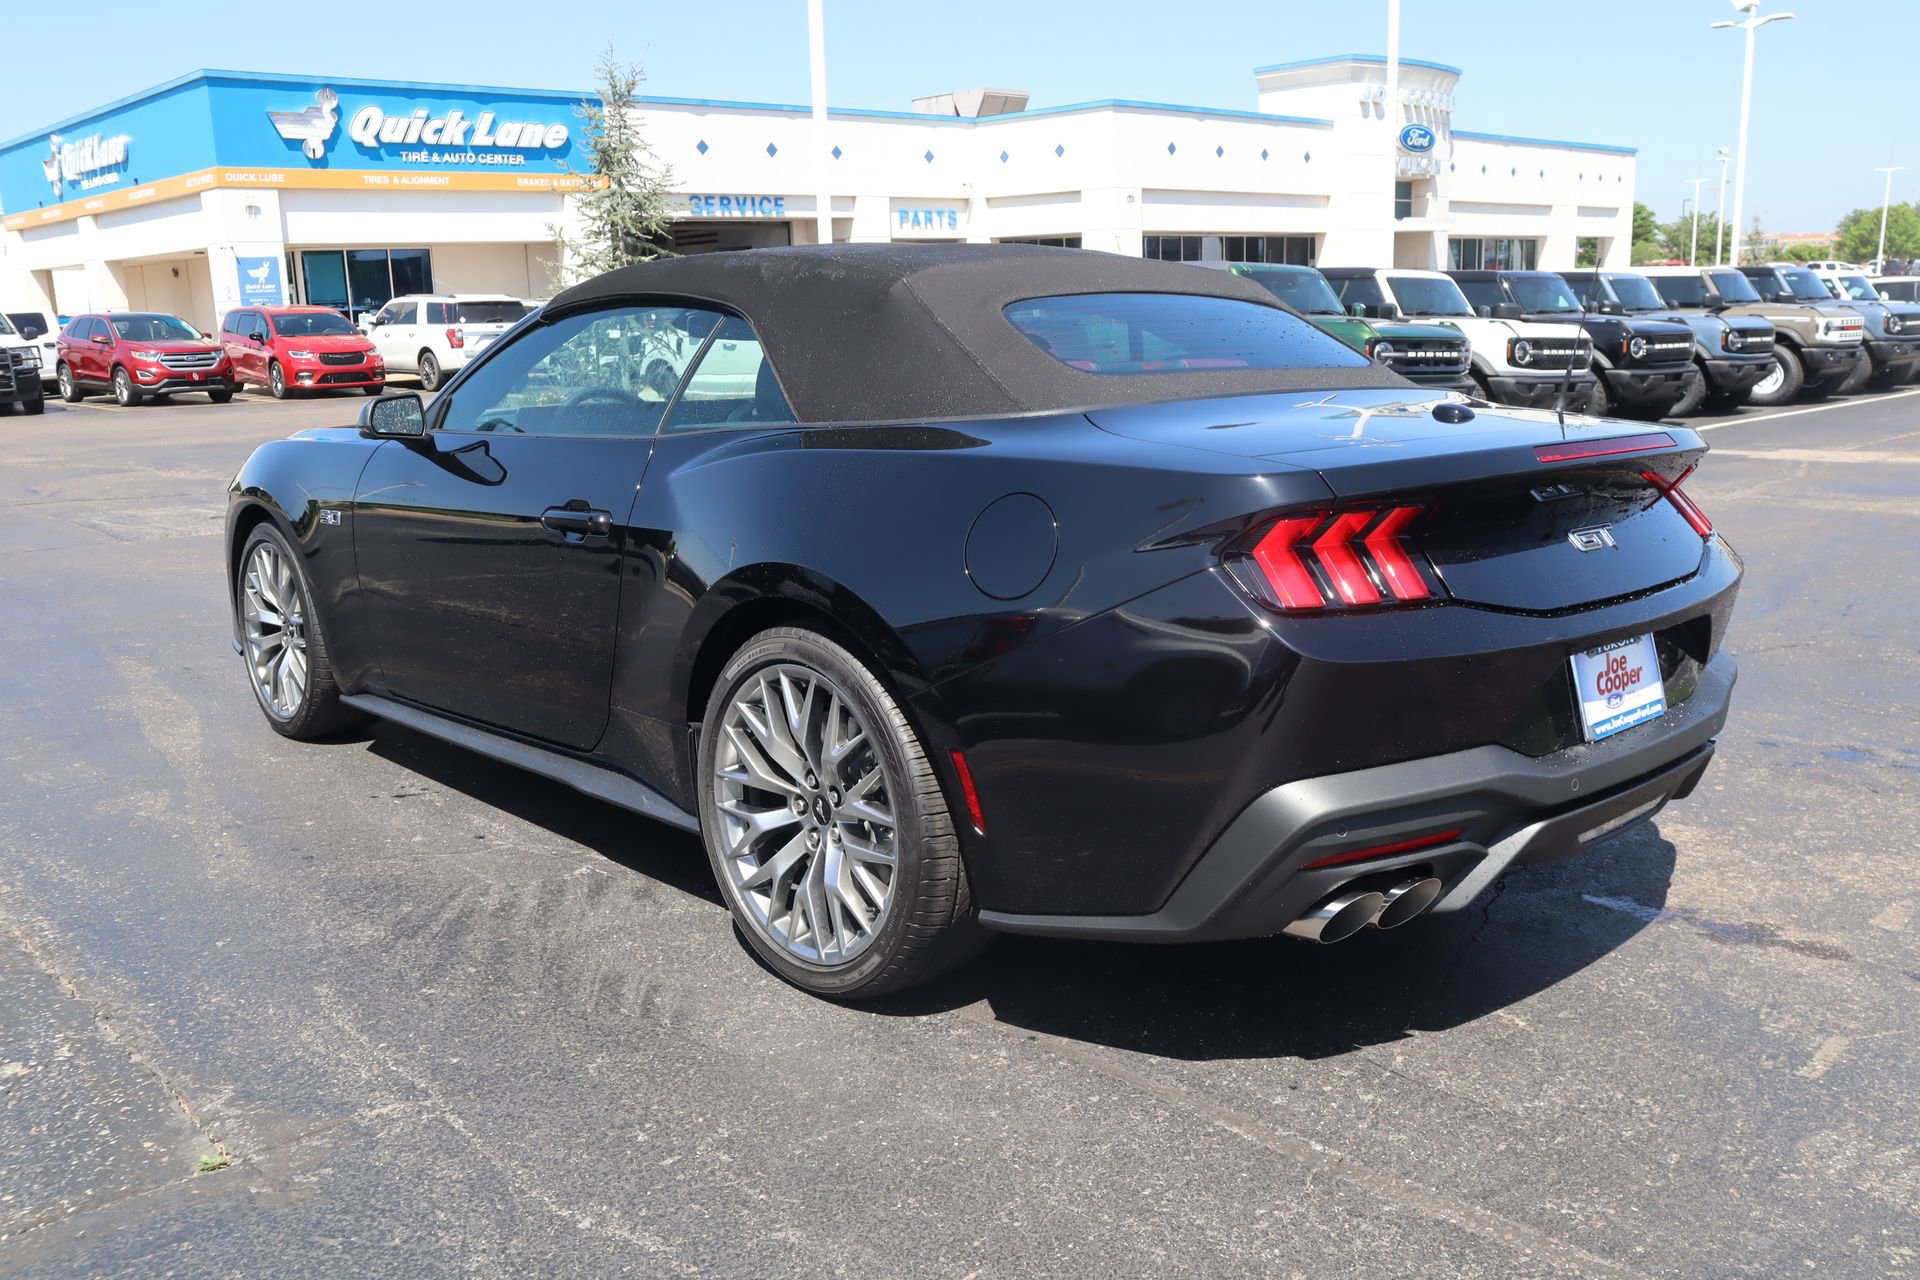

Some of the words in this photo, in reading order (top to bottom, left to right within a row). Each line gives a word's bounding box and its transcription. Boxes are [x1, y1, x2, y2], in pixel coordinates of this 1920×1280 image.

[349, 105, 473, 148] Quick
[469, 110, 569, 149] Lane
[1405, 127, 1431, 148] Ford
[400, 151, 429, 163] TIRE
[431, 152, 441, 163] &
[442, 153, 476, 164] AUTO
[478, 153, 525, 165] CENTER
[224, 172, 257, 182] QUICK
[258, 173, 285, 183] LUBE
[363, 175, 390, 185] TIRES
[392, 175, 400, 185] &
[401, 175, 450, 186] ALIGNMENT
[688, 195, 786, 217] SERVICE
[898, 207, 958, 228] PARTS
[1567, 522, 1616, 552] GT
[1604, 652, 1628, 677] Joe
[1596, 666, 1643, 696] Cooper
